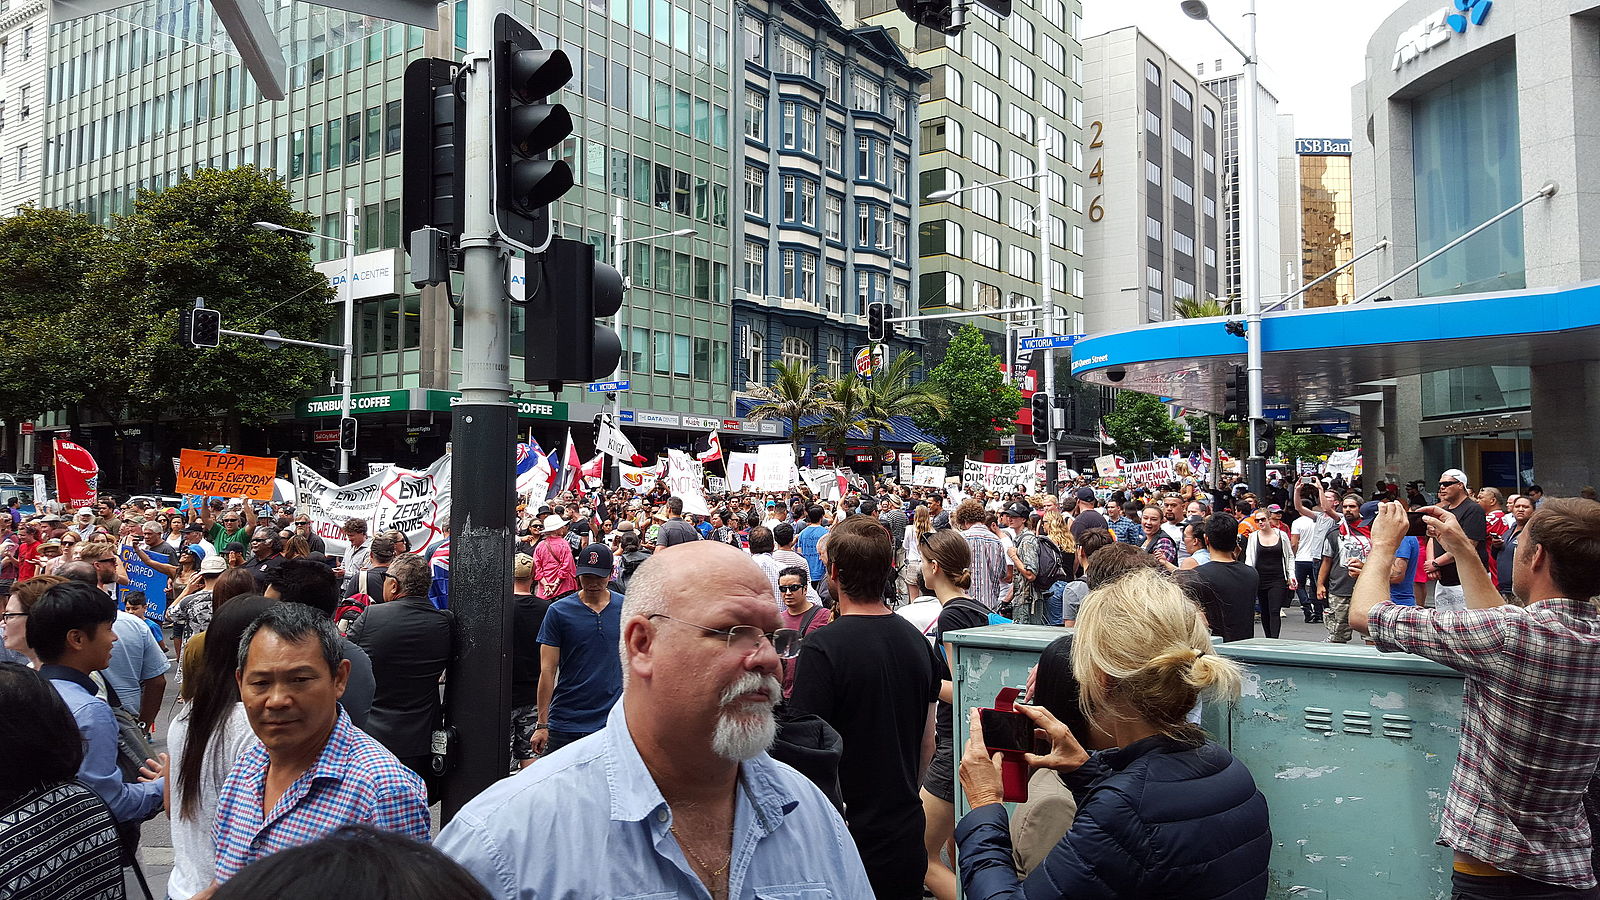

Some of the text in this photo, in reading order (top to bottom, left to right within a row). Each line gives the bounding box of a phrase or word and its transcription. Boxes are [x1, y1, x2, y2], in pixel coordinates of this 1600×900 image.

[1295, 139, 1322, 153] TSB
[1089, 120, 1104, 222] 246
[332, 267, 390, 286] DAA CENTRE
[1025, 339, 1053, 348] VICTORIA
[1092, 354, 1109, 363] Street
[307, 396, 391, 413] STARBUS COFFEE
[517, 403, 553, 416] COFFEE
[203, 454, 245, 471] TPPA
[1155, 460, 1168, 469] TU
[182, 466, 273, 485] VIOLATES EVERYDAY
[964, 473, 984, 482] OUR
[1133, 470, 1171, 482] WHENUA
[191, 480, 260, 496] KIWI RIGHTS
[399, 477, 429, 499] END
